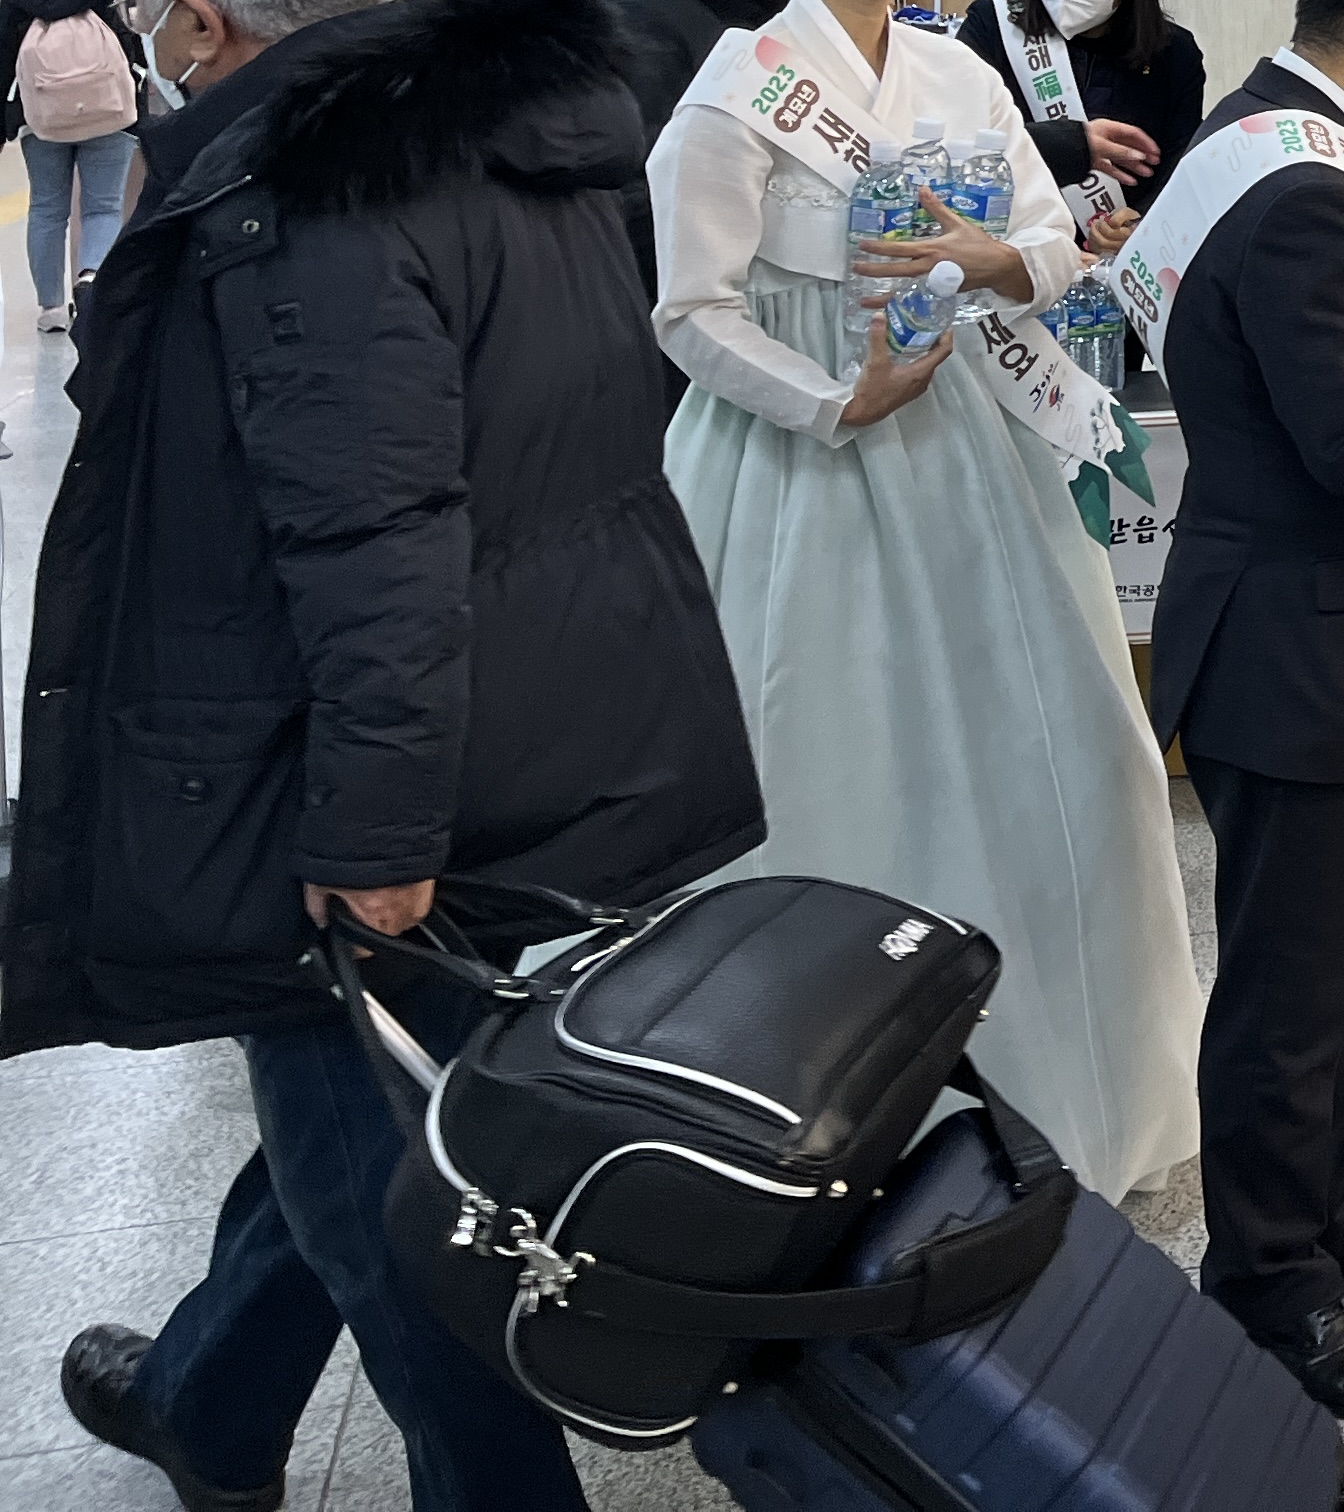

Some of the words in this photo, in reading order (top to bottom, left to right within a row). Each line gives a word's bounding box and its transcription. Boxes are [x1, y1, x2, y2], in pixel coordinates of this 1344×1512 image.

[751, 64, 796, 115] 2023
[778, 84, 817, 128] 계묘년
[1031, 69, 1064, 103] 福
[812, 107, 871, 174] 새해
[1275, 119, 1305, 154] 2023
[1130, 250, 1163, 301] 2023
